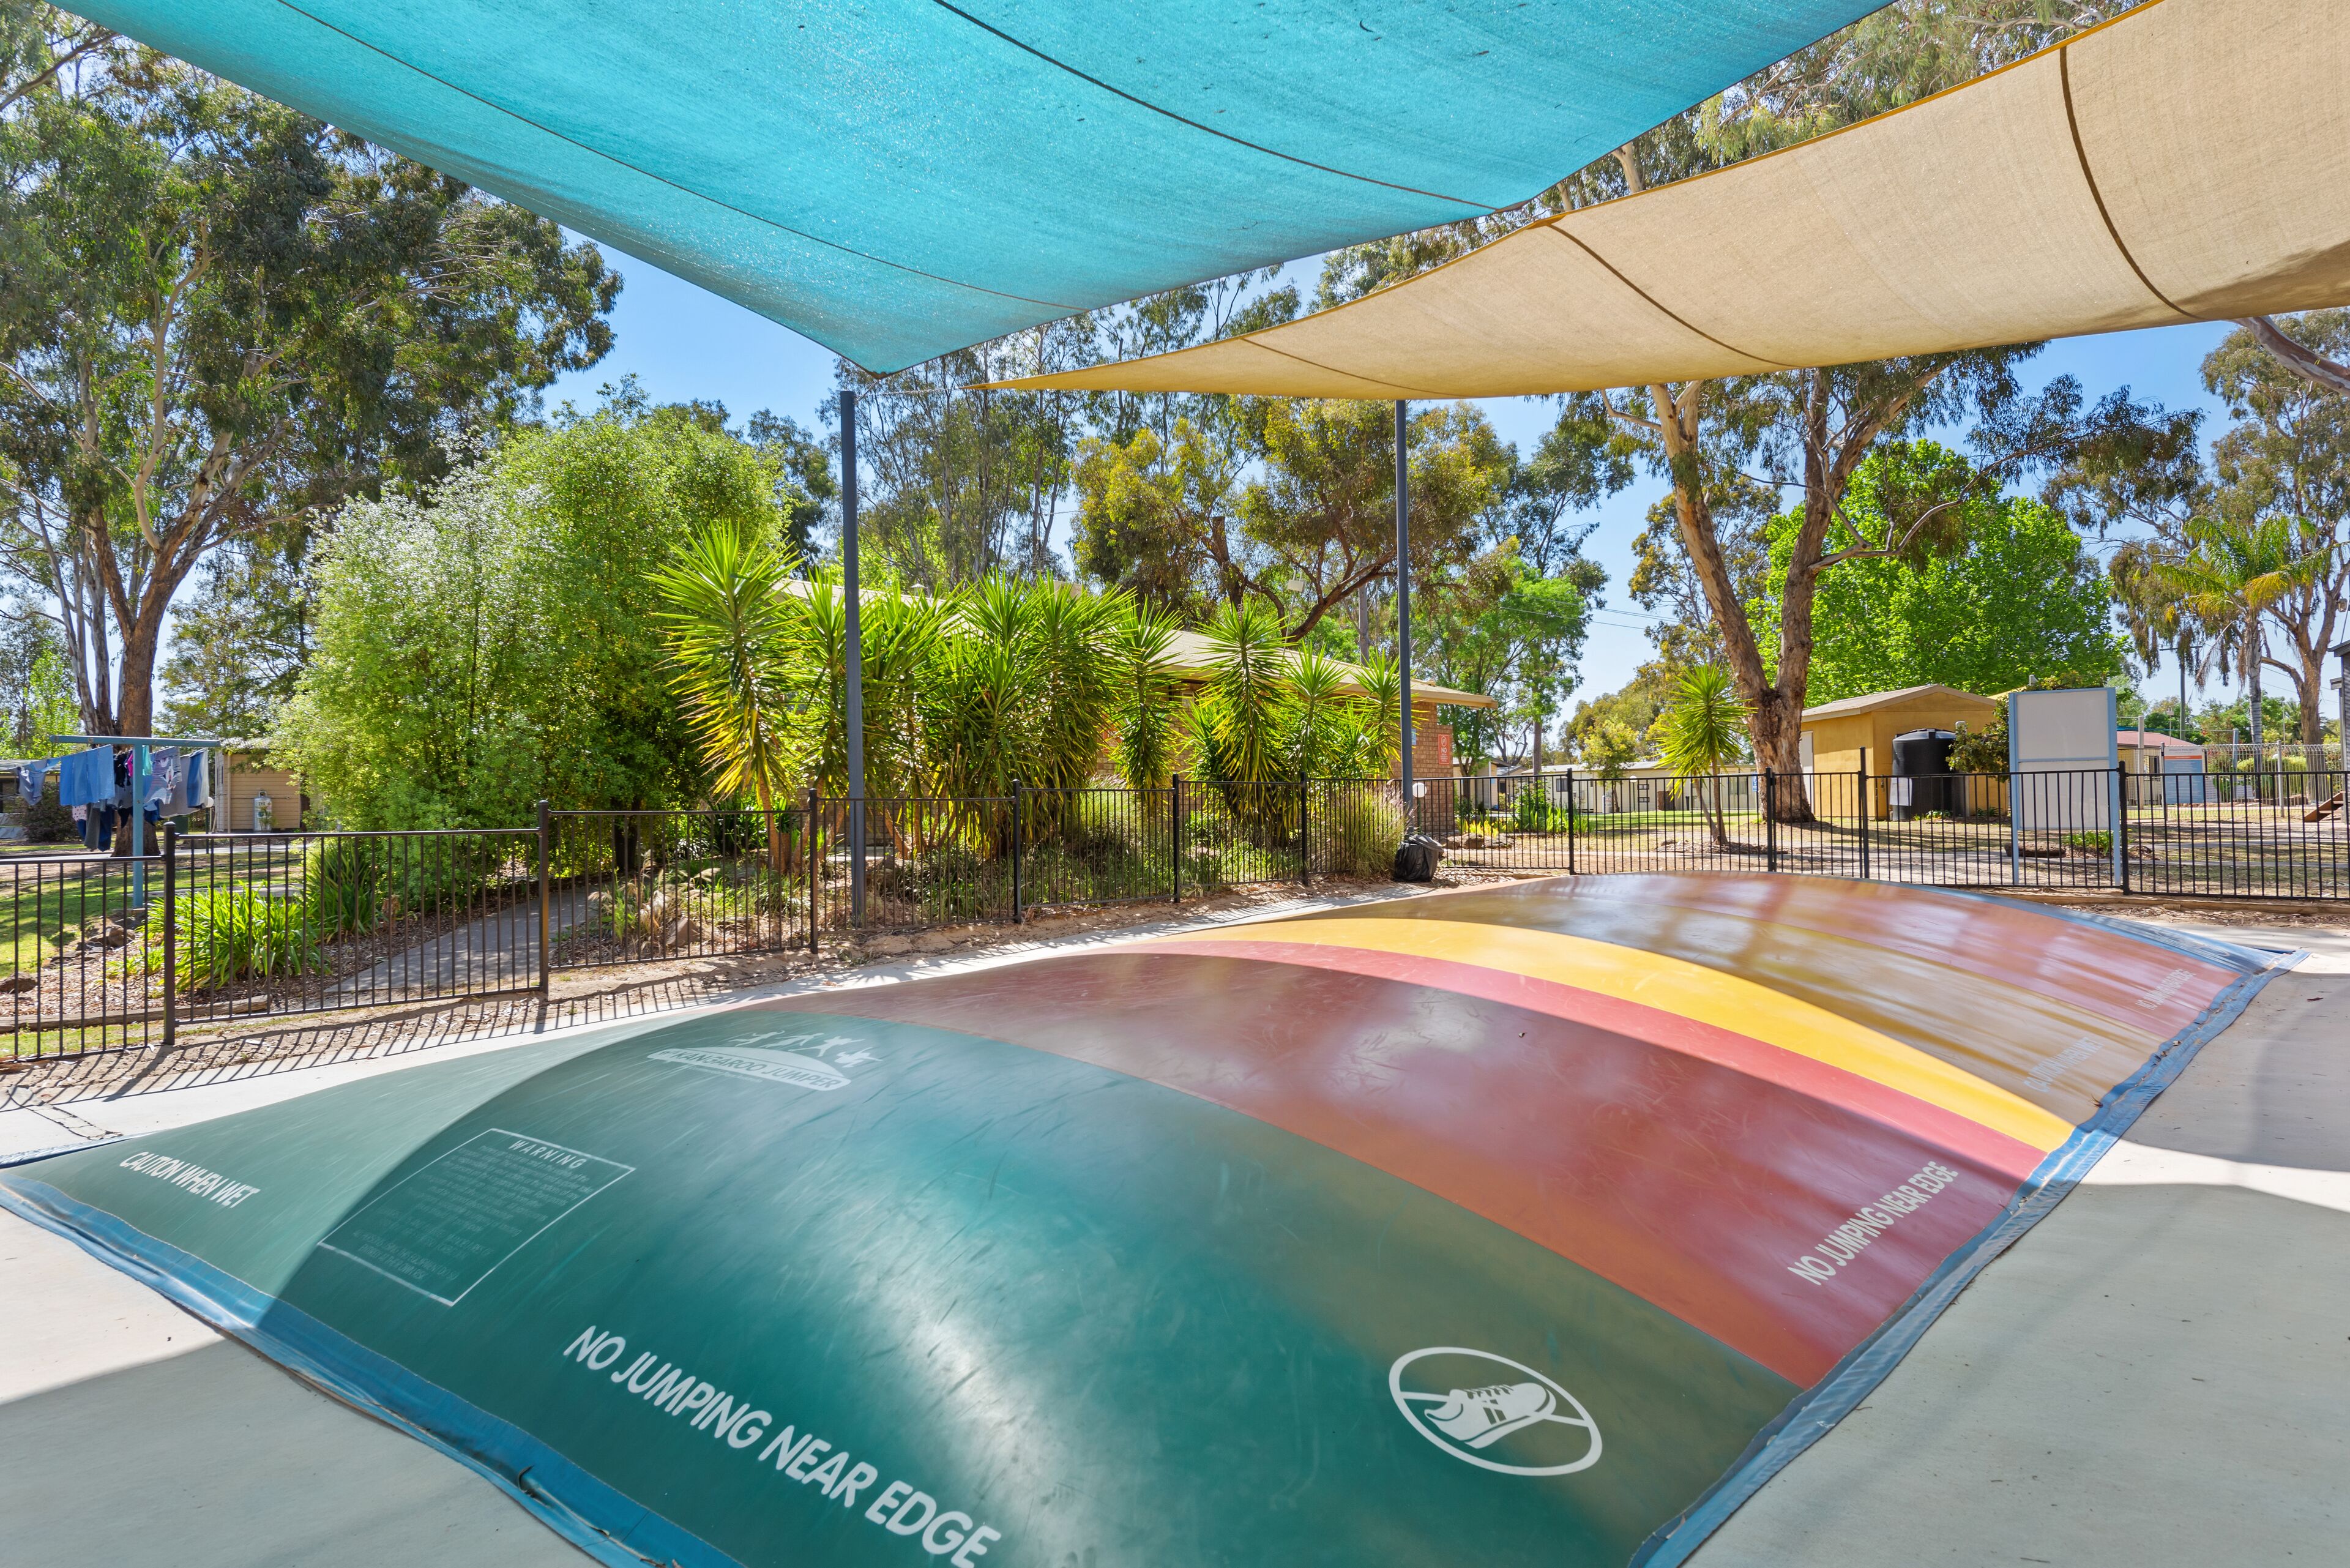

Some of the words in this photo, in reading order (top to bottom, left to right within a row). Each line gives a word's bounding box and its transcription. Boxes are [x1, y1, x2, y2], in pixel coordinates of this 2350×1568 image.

[670, 1051, 767, 1071] KANGAROO
[761, 1067, 842, 1088] JUMPER
[119, 1152, 185, 1180] CAUTION
[171, 1163, 229, 1197] WHEN
[210, 1181, 261, 1208] WET
[509, 1140, 587, 1169] WARNING
[1788, 1256, 1836, 1285] NO
[1815, 1208, 1894, 1266] JUMPING
[1873, 1185, 1932, 1218] NEAR
[1908, 1161, 1958, 1193] EDGE
[564, 1325, 625, 1370] NO
[611, 1351, 772, 1449] JUMPING
[758, 1425, 878, 1507] NEAR
[865, 1480, 1002, 1568] EDGE
